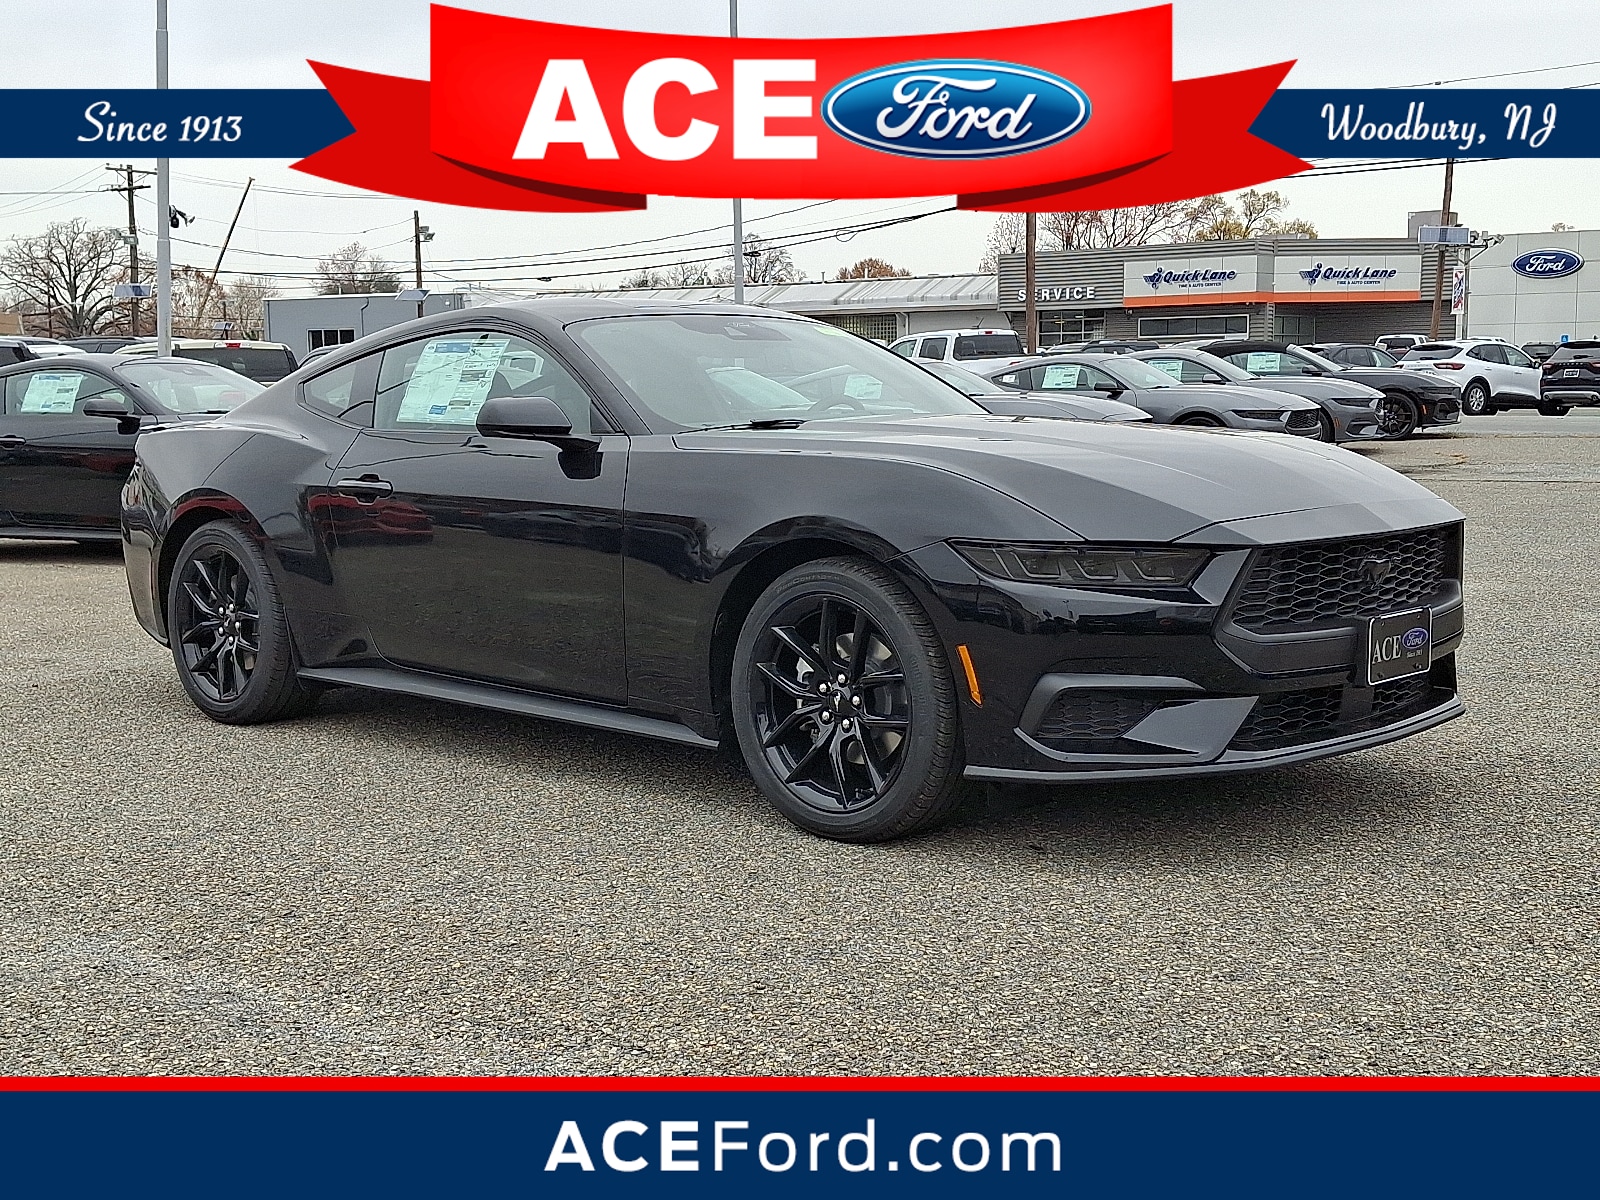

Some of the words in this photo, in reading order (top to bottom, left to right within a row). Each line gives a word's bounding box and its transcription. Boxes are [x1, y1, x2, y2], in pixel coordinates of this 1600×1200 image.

[1525, 255, 1566, 272] Ford
[1163, 269, 1201, 284] Quick
[1201, 269, 1236, 281] Lane
[1323, 267, 1361, 280] Quick
[1363, 266, 1397, 279] Lane
[1372, 635, 1401, 664] ACE
[1406, 632, 1424, 646] Ford
